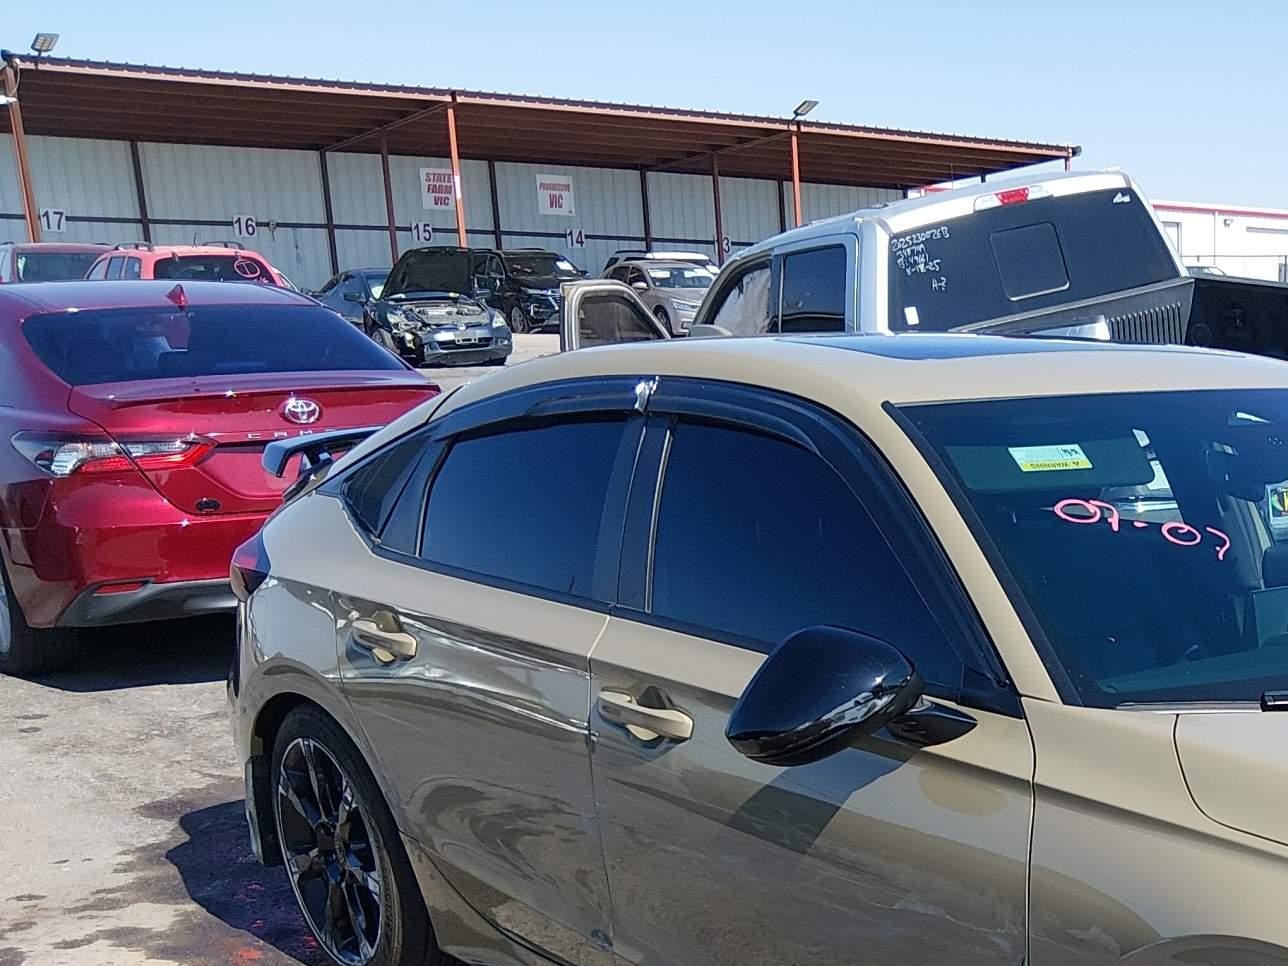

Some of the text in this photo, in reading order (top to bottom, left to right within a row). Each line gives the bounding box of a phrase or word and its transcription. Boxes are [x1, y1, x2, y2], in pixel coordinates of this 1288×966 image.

[425, 172, 452, 183] STATE
[427, 184, 452, 194] FARM
[433, 196, 450, 206] VIC
[549, 193, 563, 208] VIC
[41, 210, 64, 231] 17
[234, 216, 256, 236] 16
[413, 223, 432, 242] 15
[567, 229, 584, 247] 14
